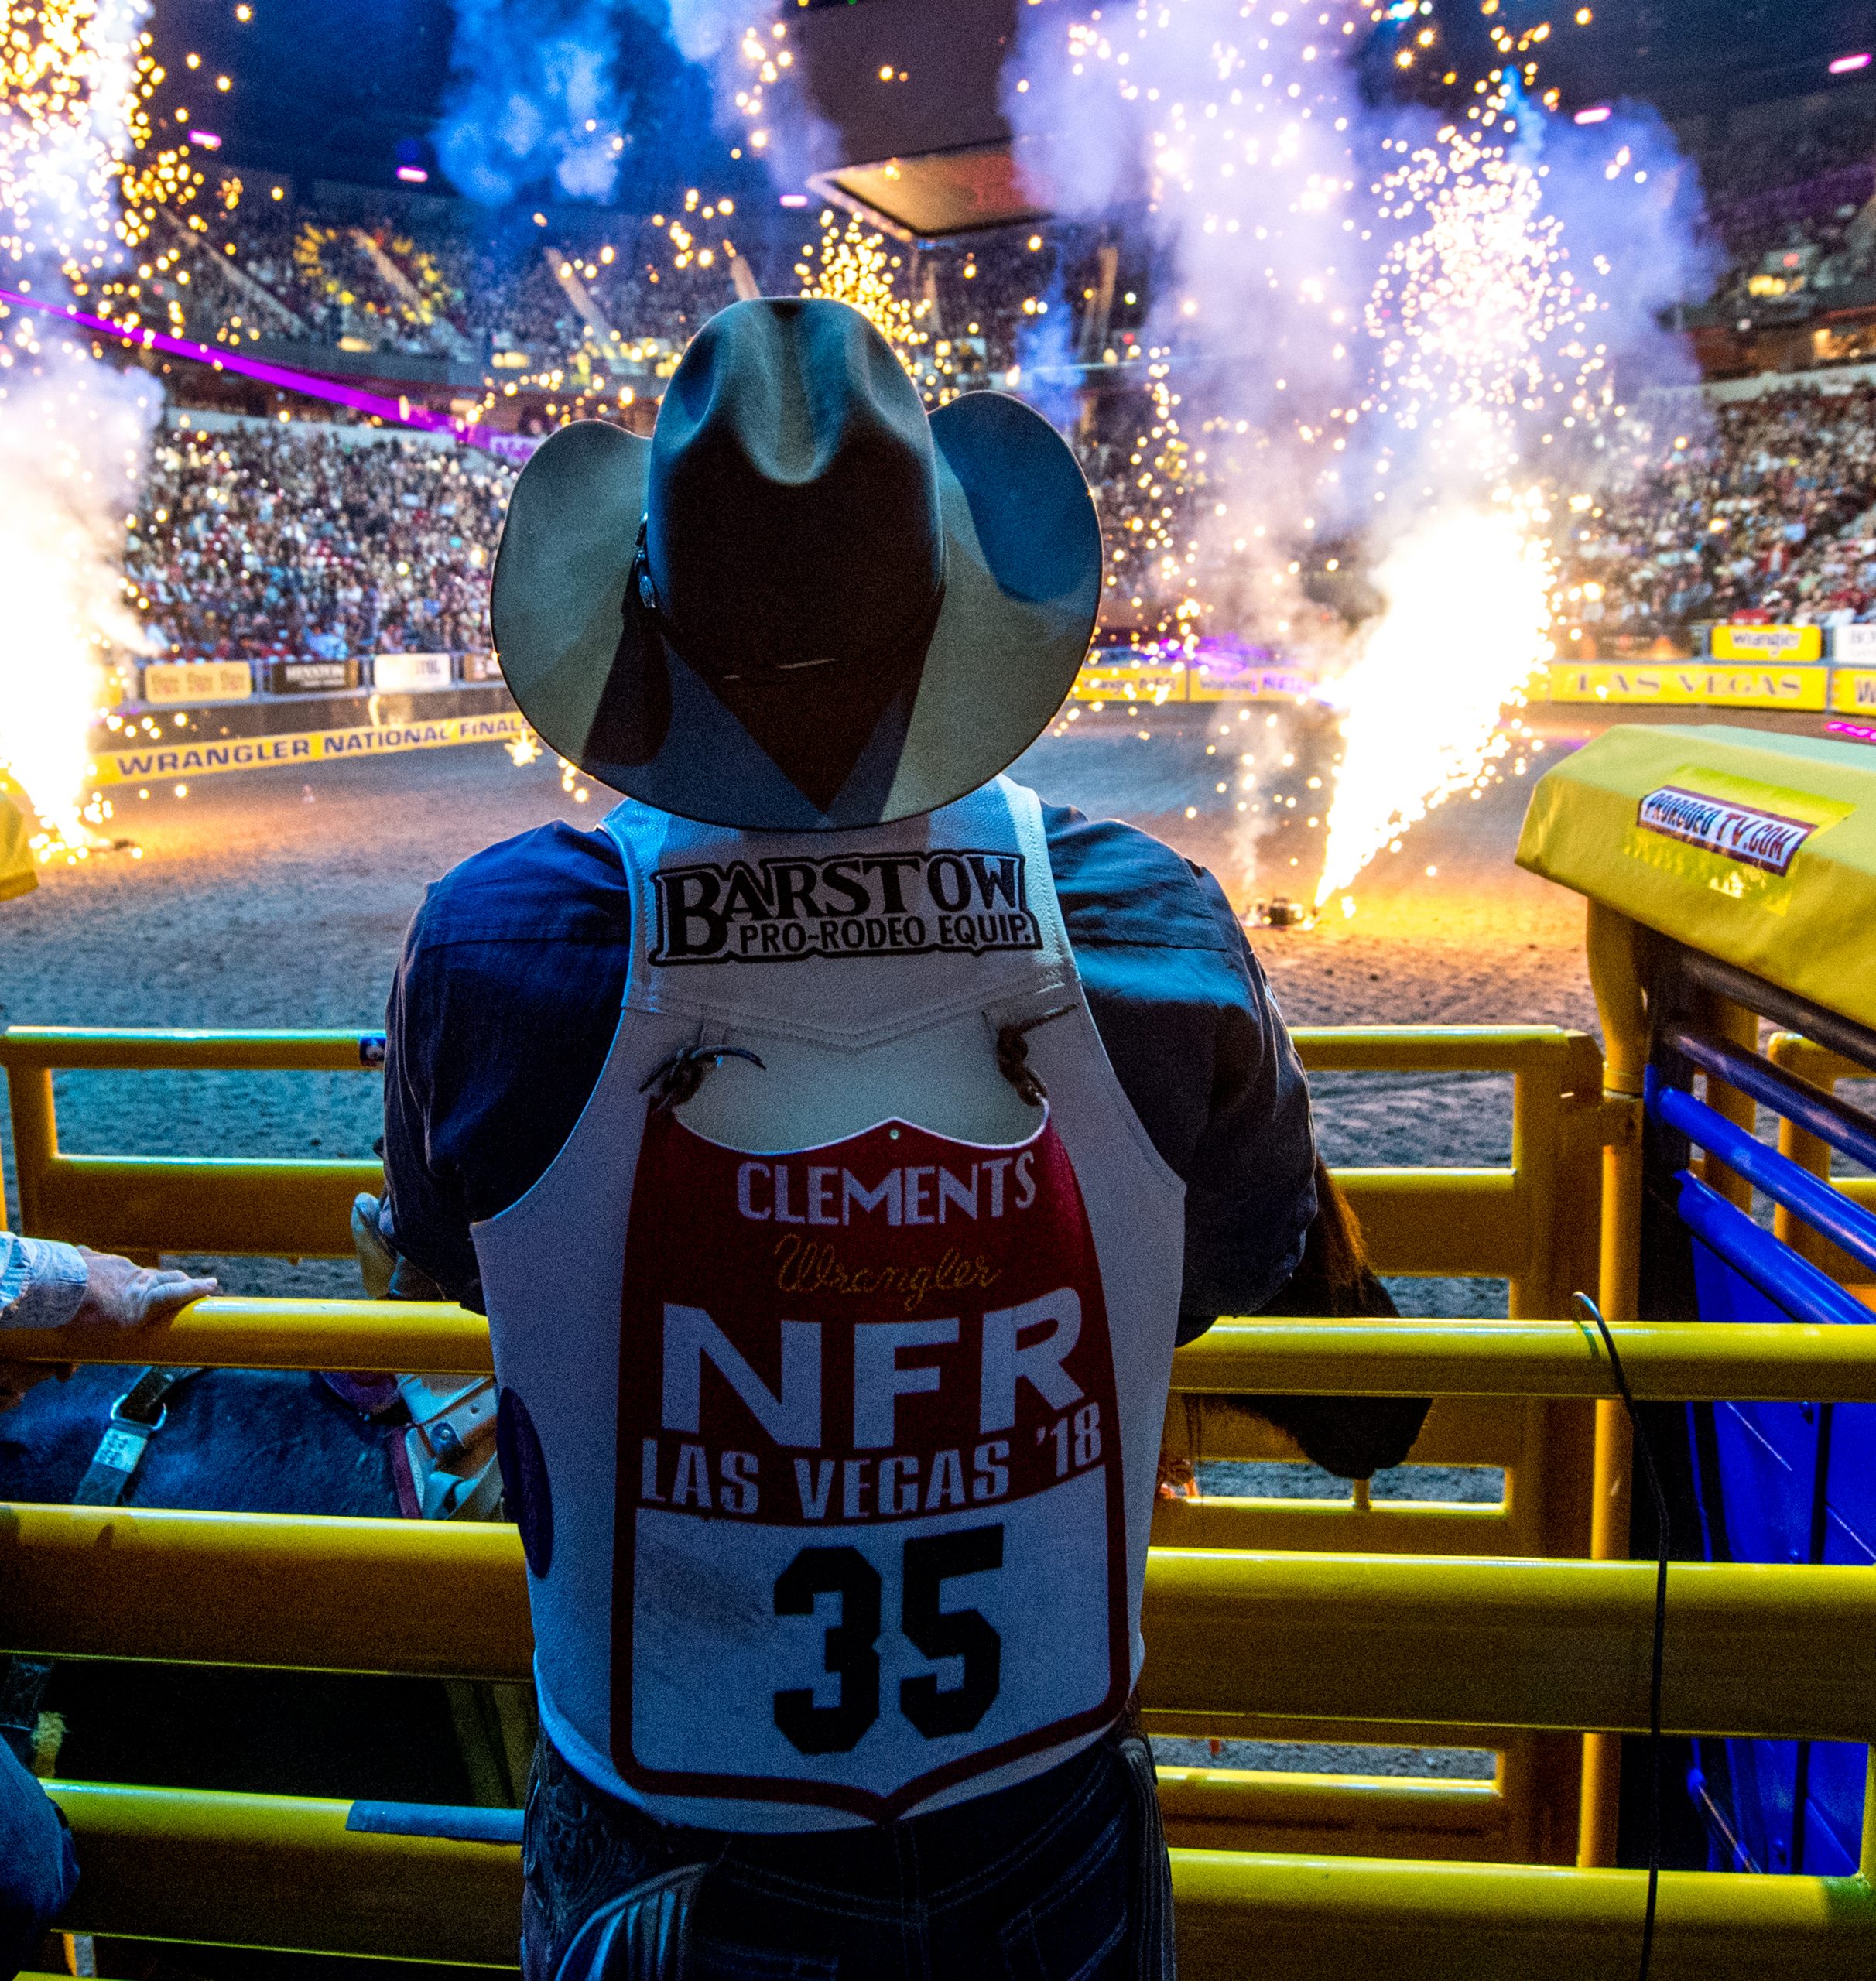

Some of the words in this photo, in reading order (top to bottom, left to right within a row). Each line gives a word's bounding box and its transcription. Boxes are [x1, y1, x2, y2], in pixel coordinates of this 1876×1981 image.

[1679, 673, 1802, 697] VEGAS
[116, 740, 310, 775] WRANGLER
[324, 725, 450, 753] NATIONAL
[662, 854, 1019, 958] BARSTOW
[740, 915, 925, 955] PRO-RODEO
[940, 913, 1032, 946] EQUIP.
[737, 1150, 1036, 1227] CLEMENTS
[773, 1233, 1001, 1312] Wrangler
[661, 1285, 1086, 1449] NFR
[641, 1437, 760, 1515] LAS
[793, 1439, 1010, 1520] VEGAS
[1037, 1401, 1102, 1477] '18
[774, 1522, 1005, 1755] 35
